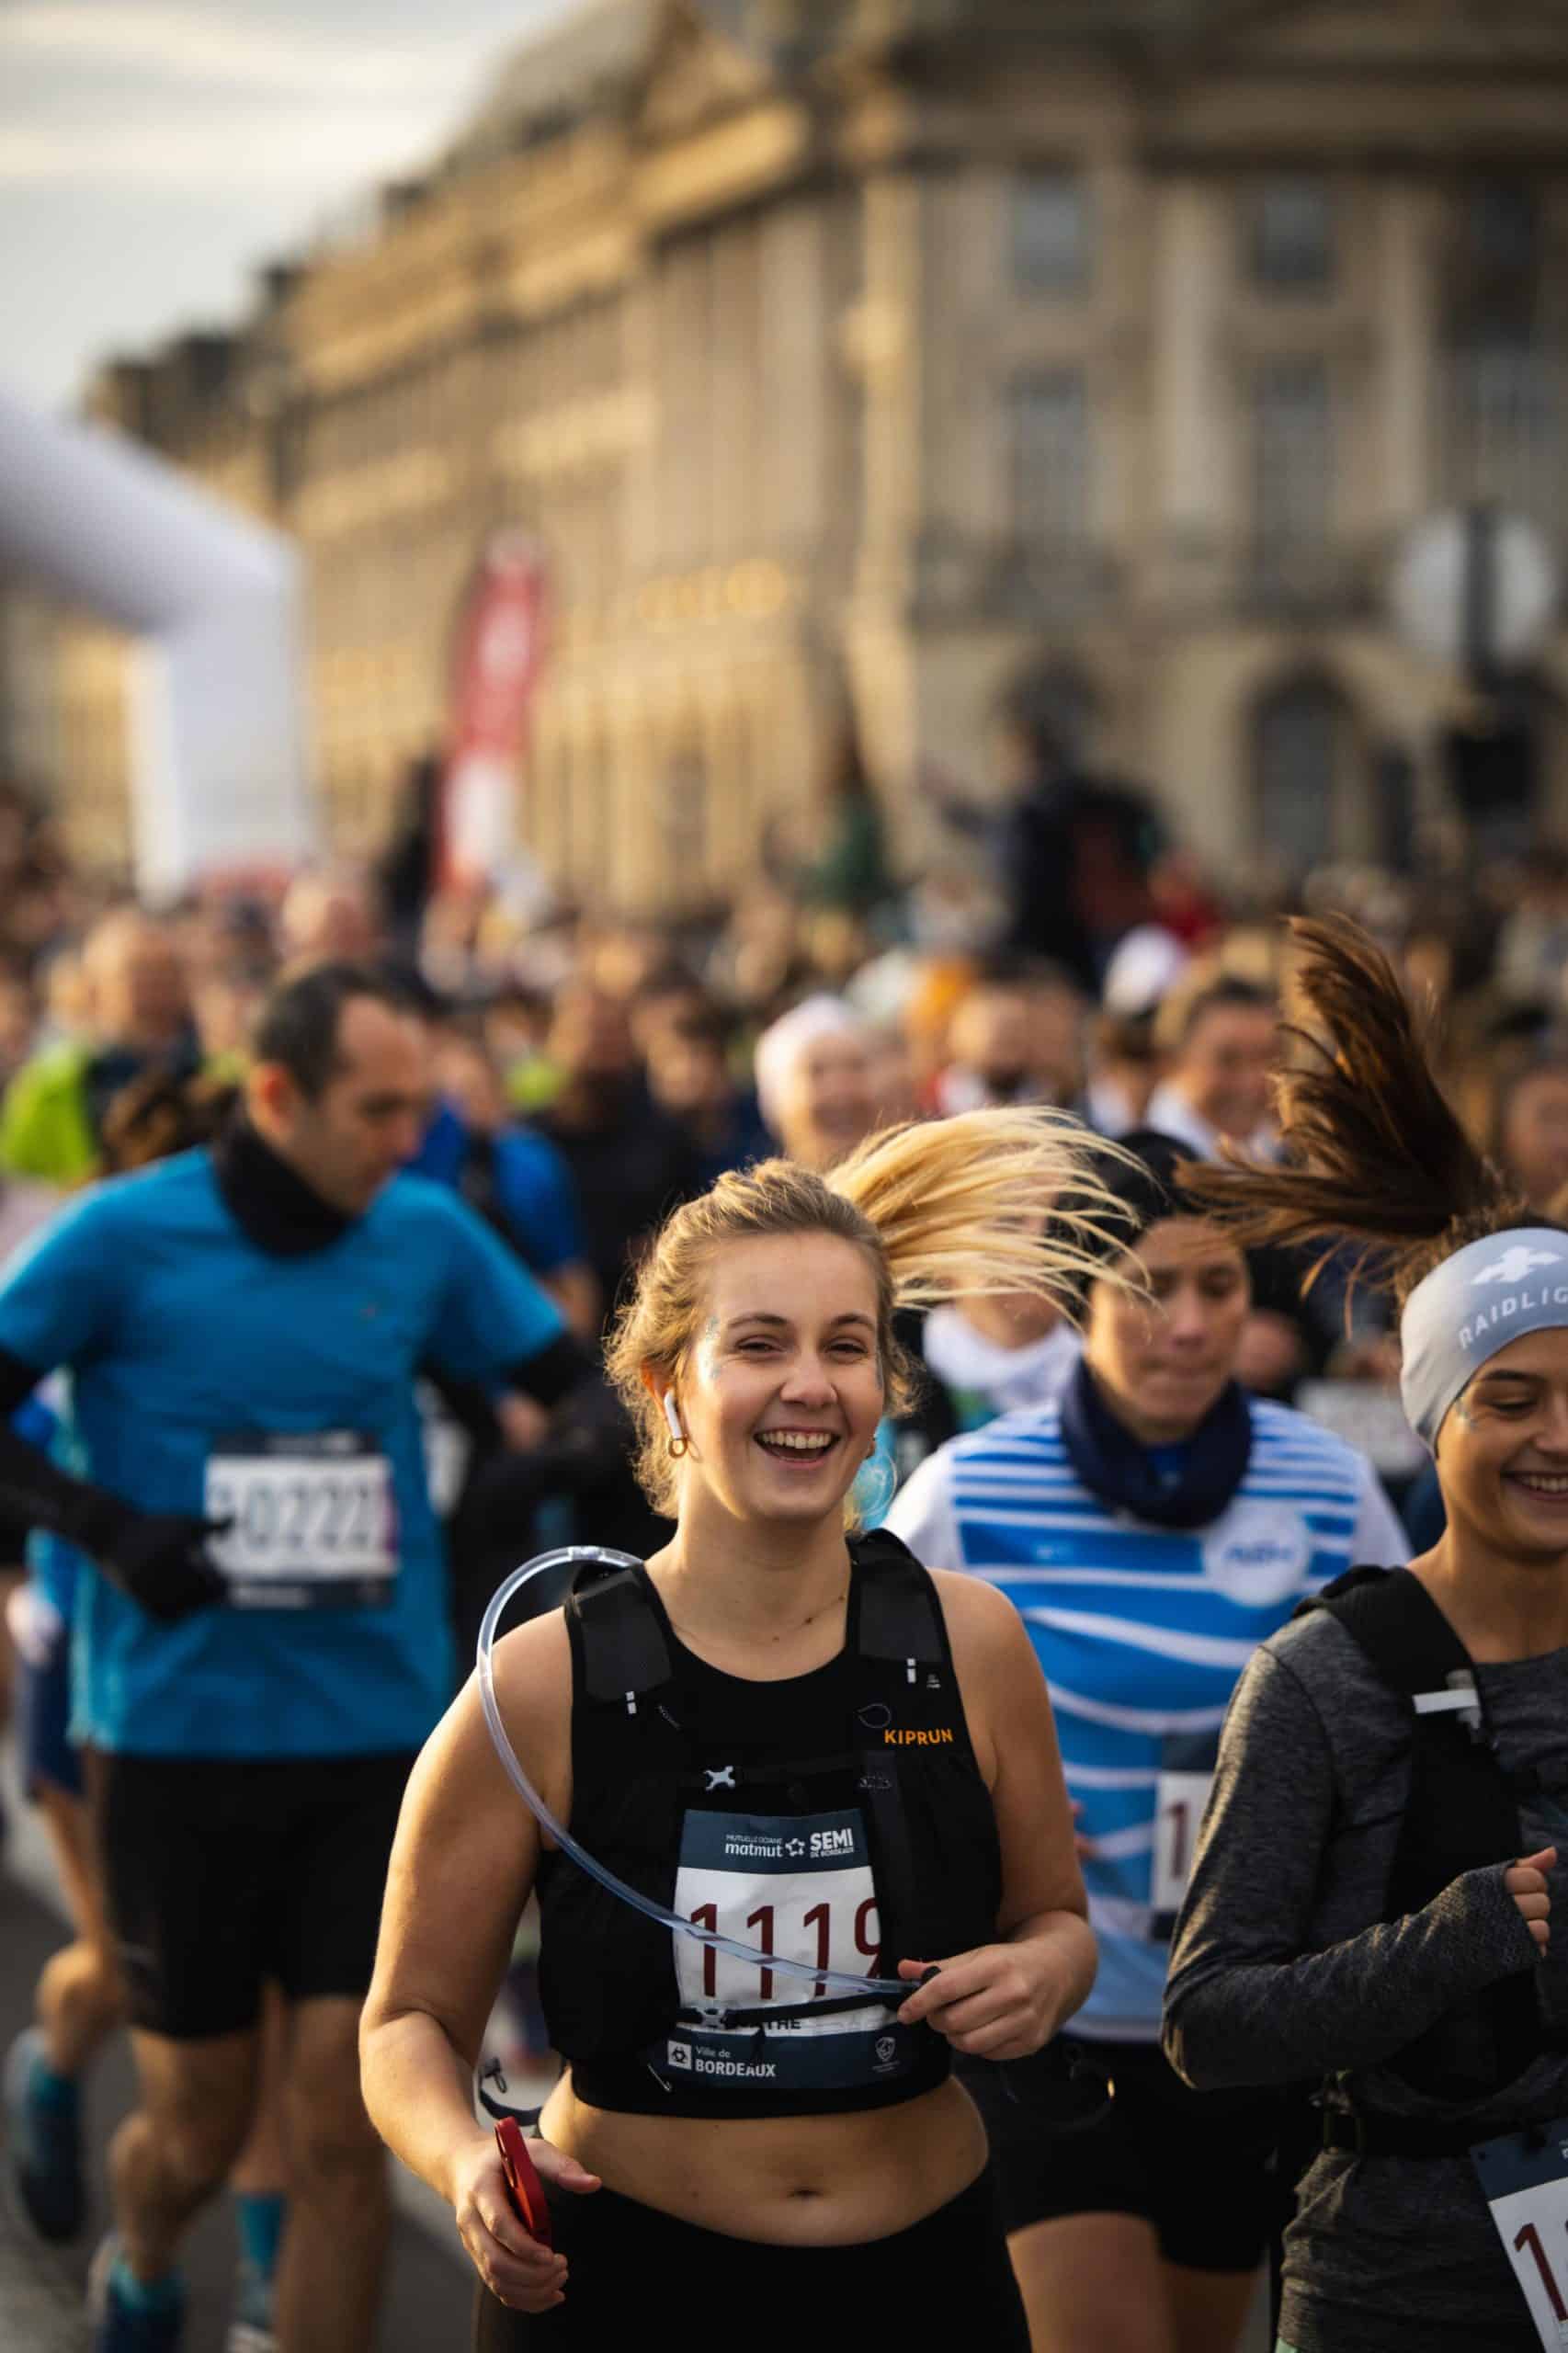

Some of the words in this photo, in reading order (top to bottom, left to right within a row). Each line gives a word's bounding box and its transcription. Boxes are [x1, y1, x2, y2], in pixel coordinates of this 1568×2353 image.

[884, 1728, 954, 1745] KIPRUN
[810, 1827, 854, 1851] SEMI
[724, 1842, 783, 1858] matmut
[696, 2045, 716, 2057] Ville
[718, 2049, 732, 2059] de
[695, 2059, 776, 2077] BORDEAUX
